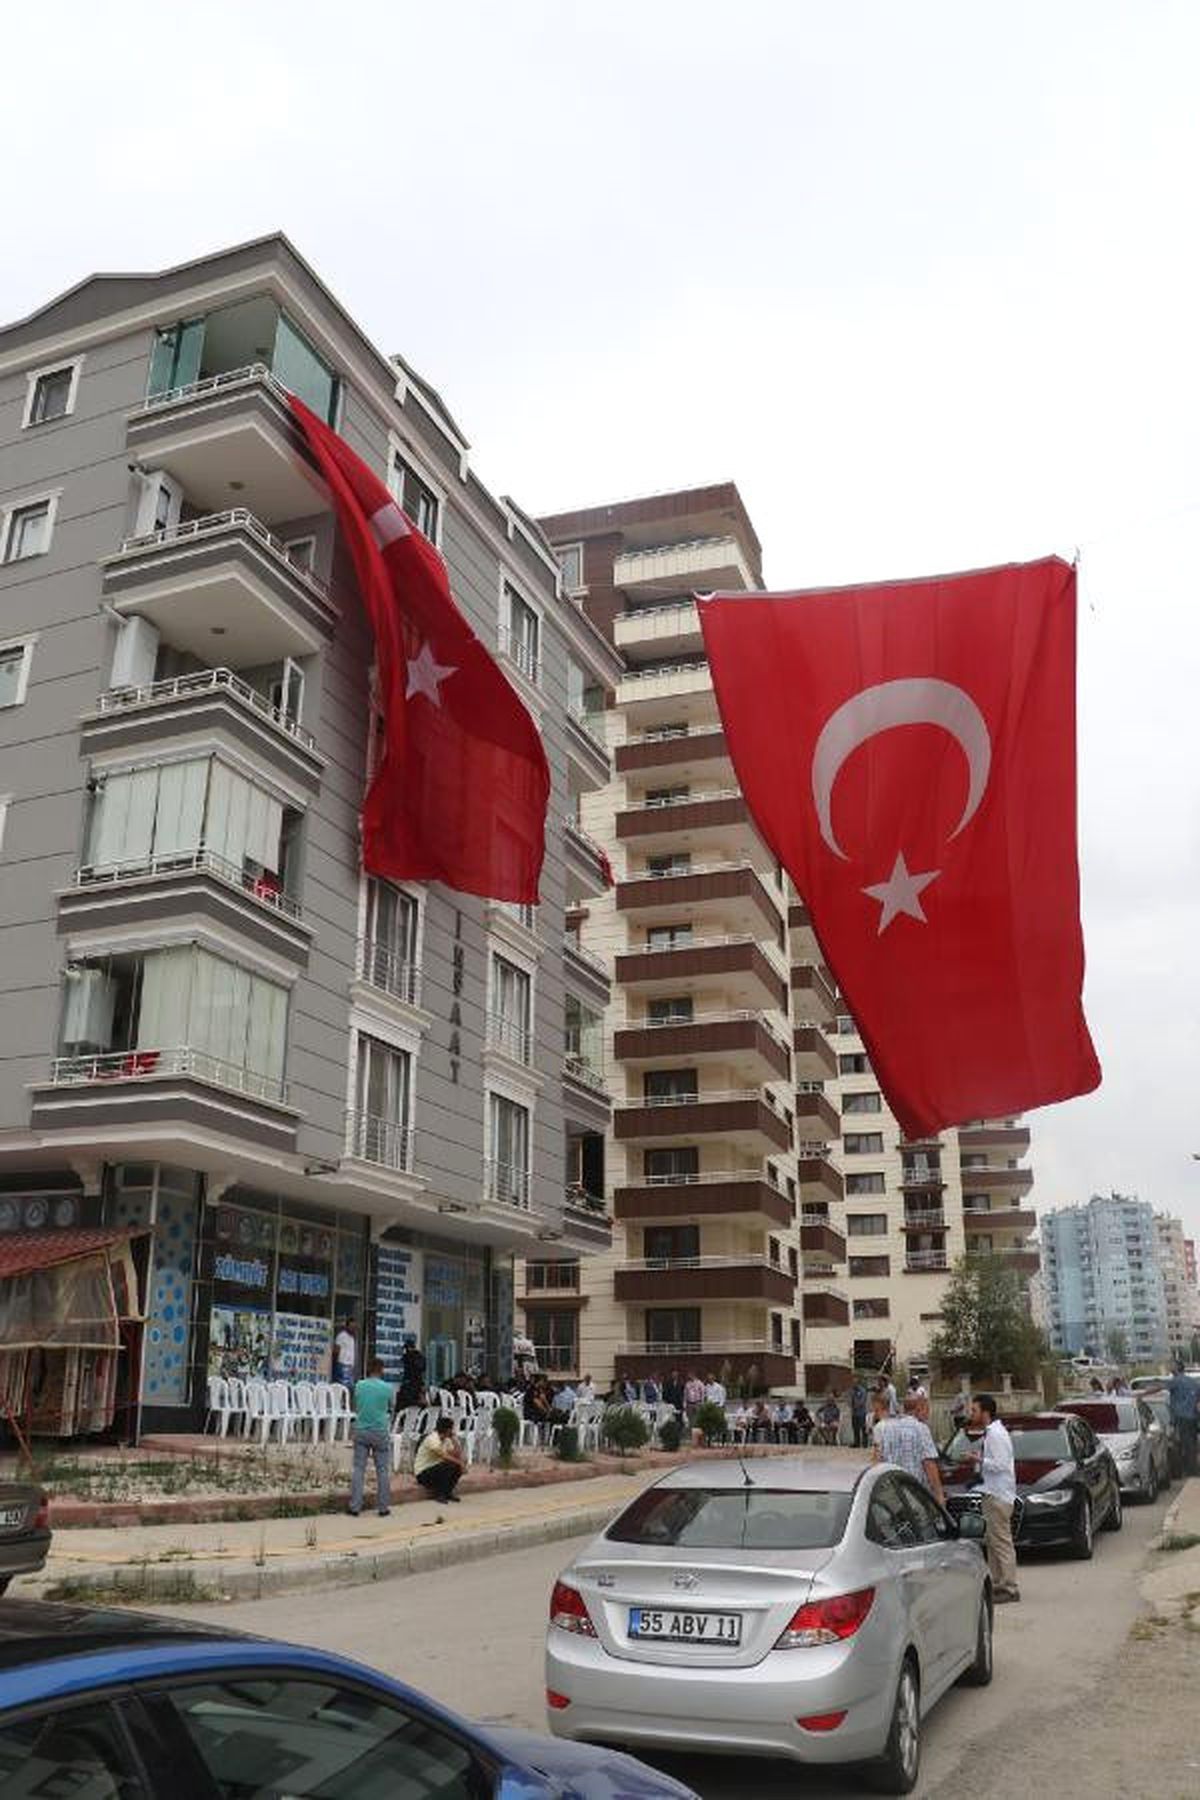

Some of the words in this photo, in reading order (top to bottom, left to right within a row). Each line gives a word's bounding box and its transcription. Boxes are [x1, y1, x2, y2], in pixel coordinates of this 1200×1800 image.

[640, 1612, 663, 1632] 55
[670, 1615, 708, 1635] ABV
[717, 1617, 736, 1638] 11
